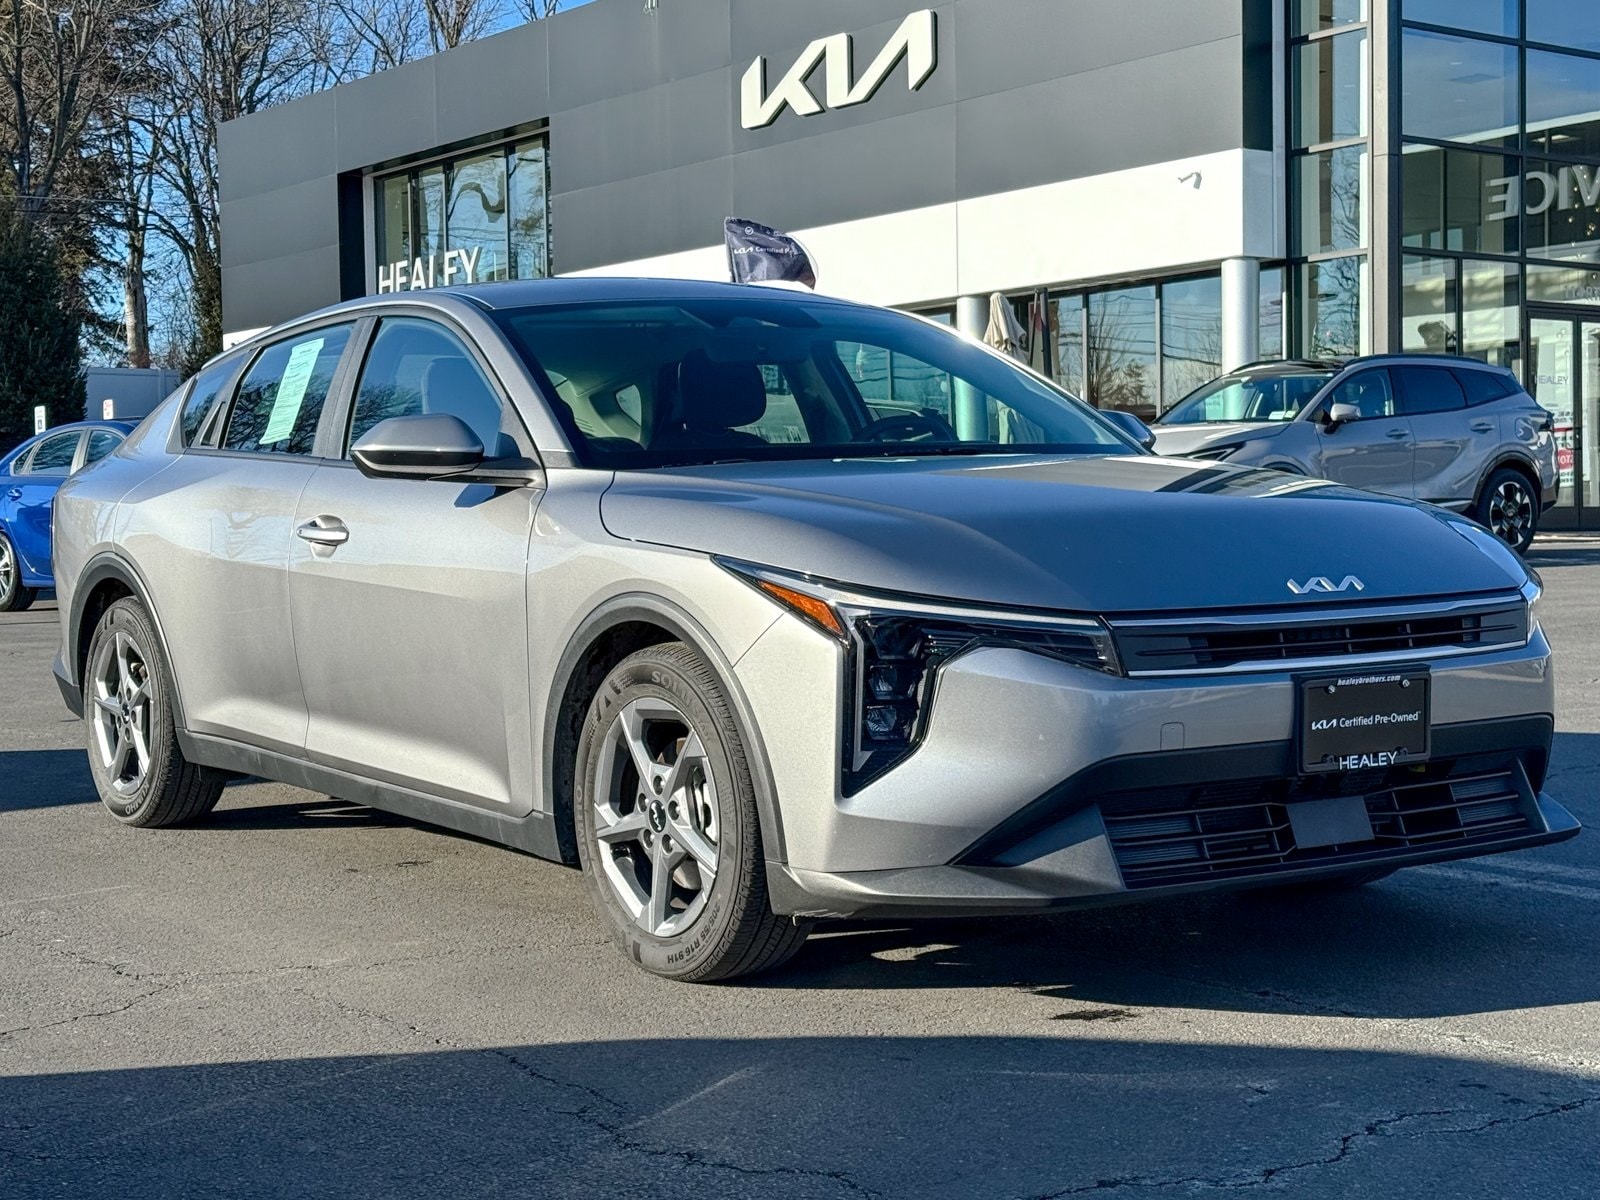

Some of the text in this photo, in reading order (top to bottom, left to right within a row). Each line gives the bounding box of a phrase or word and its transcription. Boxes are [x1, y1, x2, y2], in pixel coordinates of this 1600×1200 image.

[741, 9, 935, 129] KIA
[378, 246, 480, 294] HEALEY
[1286, 575, 1365, 594] KIA
[1336, 675, 1402, 686] healeybrothers.com
[1311, 718, 1337, 730] KIA
[1339, 714, 1374, 728] Certified
[1339, 751, 1398, 770] HEALEY
[667, 951, 684, 964] 91H
